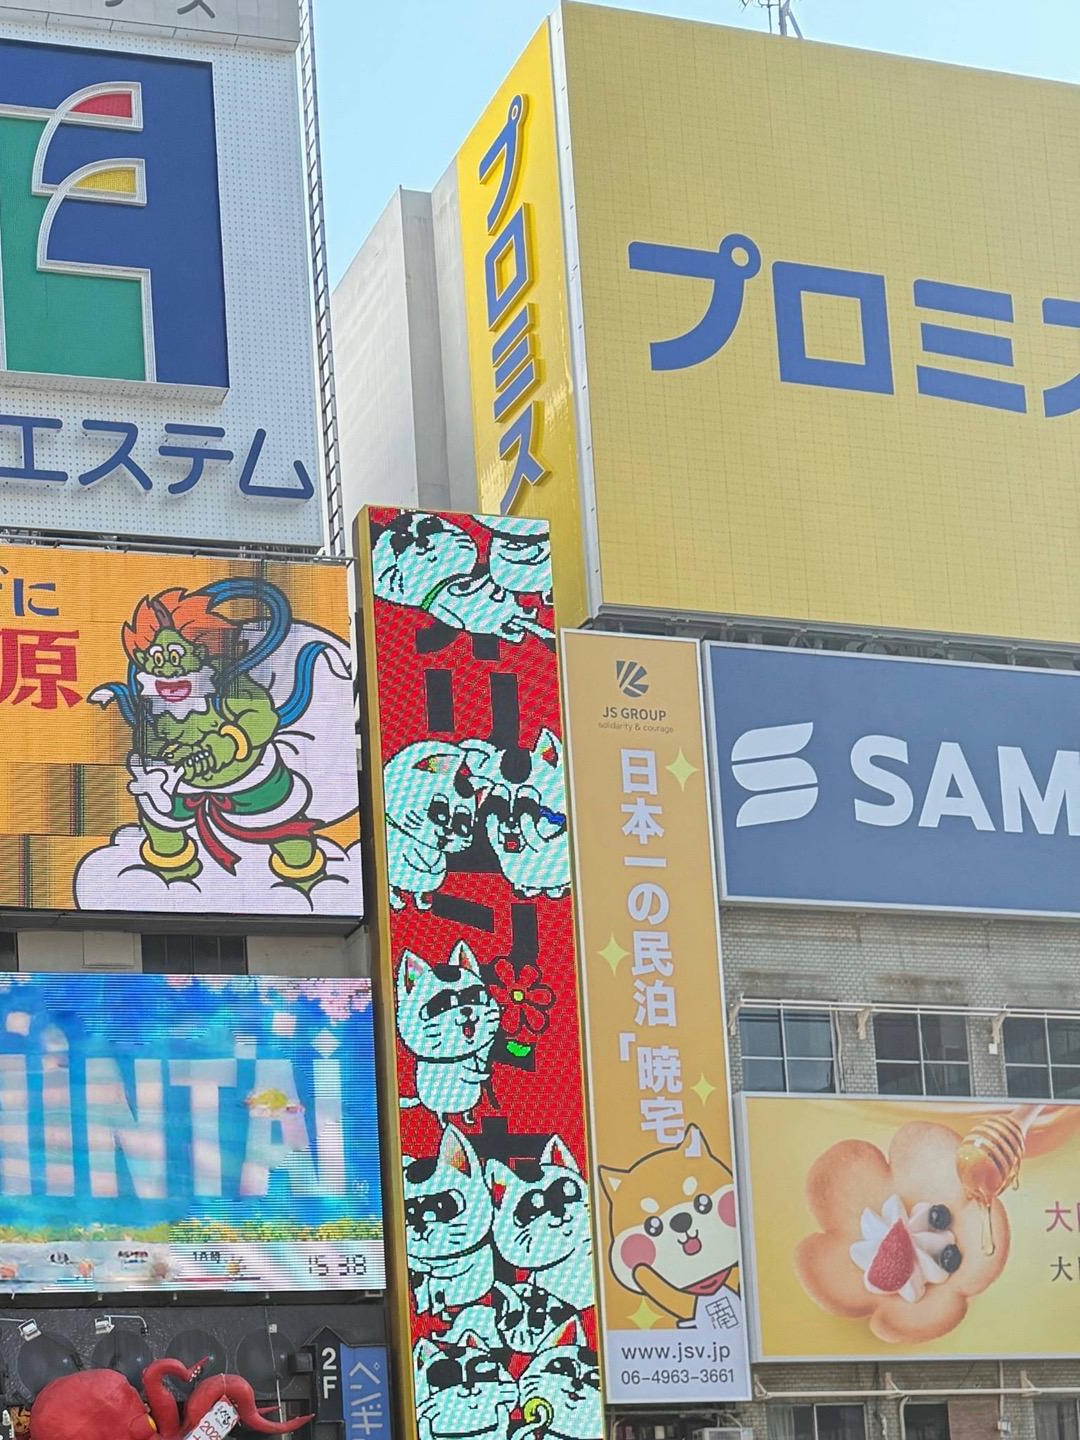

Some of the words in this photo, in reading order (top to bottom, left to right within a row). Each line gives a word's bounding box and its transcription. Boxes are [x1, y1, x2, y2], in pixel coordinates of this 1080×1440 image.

[478, 93, 551, 516] プロミス
[602, 706, 618, 719] JS
[620, 707, 667, 721] GROUP
[850, 734, 1080, 837] SAM
[621, 1341, 731, 1363] www.jsv.jp
[621, 1368, 735, 1385] 06-4963-3661
